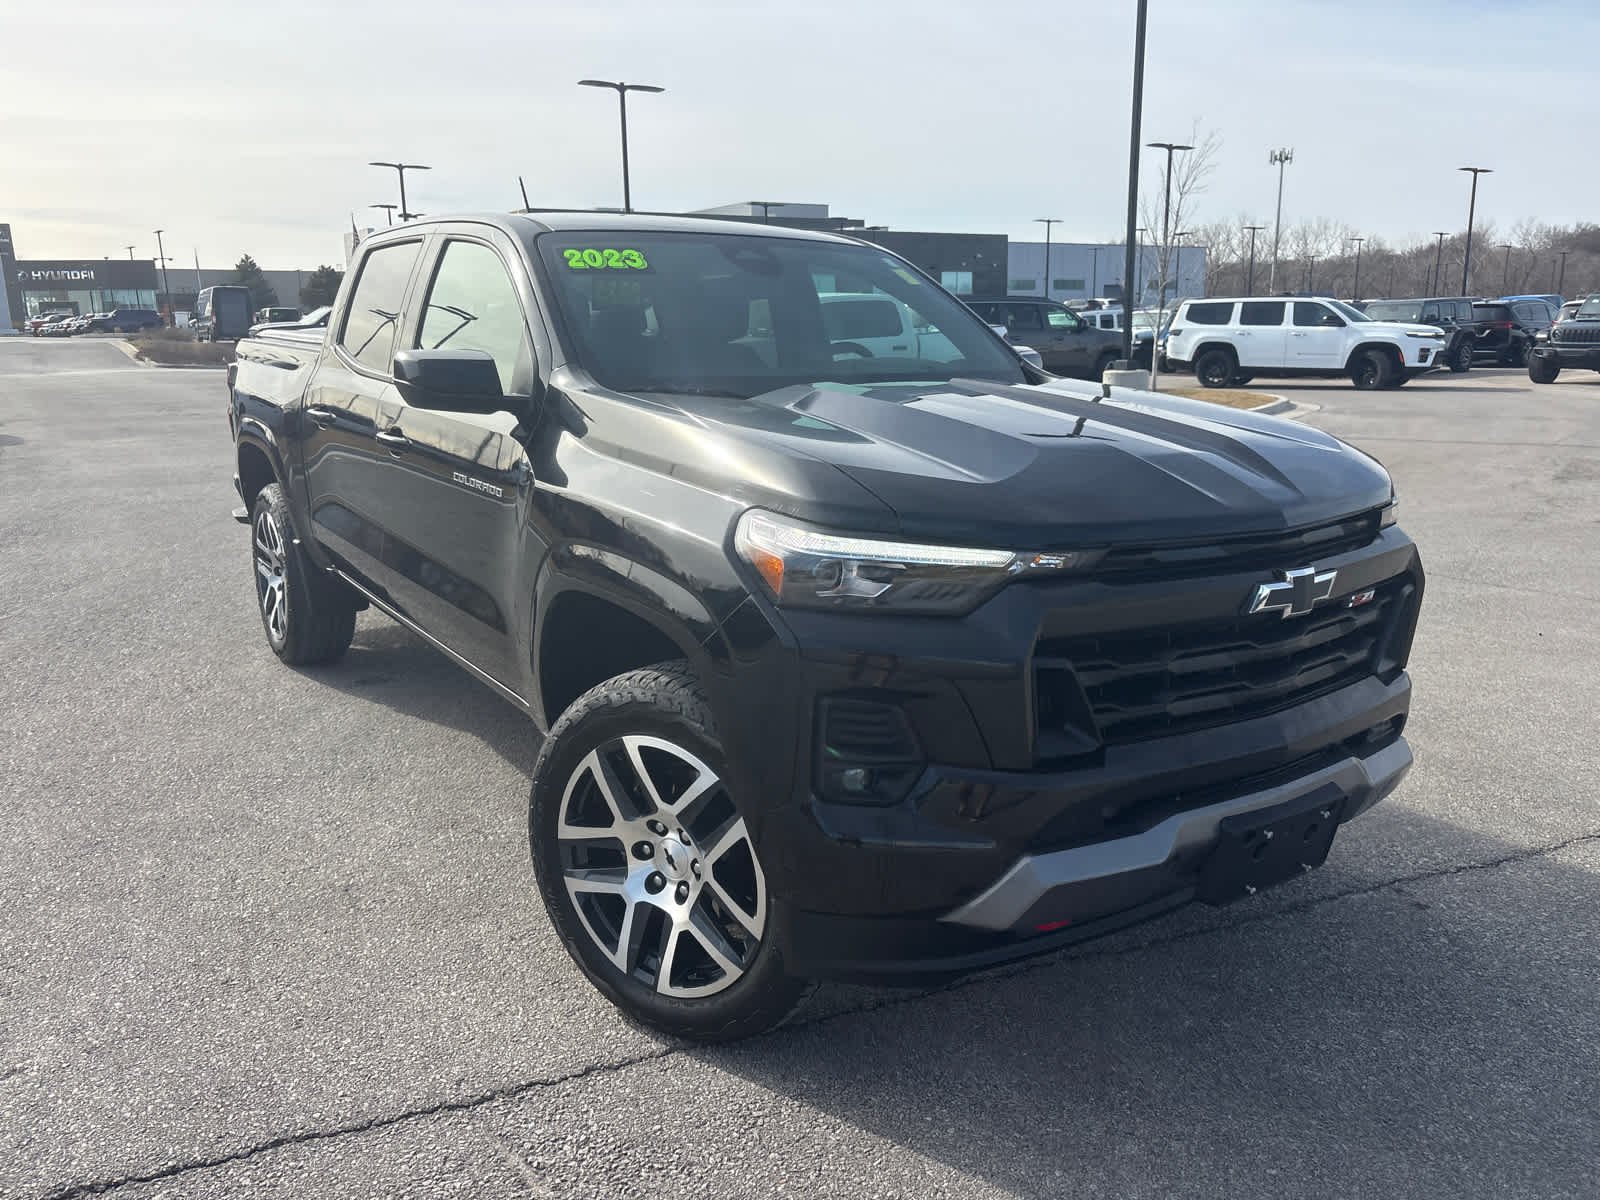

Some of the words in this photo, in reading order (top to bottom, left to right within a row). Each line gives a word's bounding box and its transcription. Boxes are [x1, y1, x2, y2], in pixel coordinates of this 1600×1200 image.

[563, 248, 648, 270] 2023
[31, 270, 95, 281] HYUNDAI
[453, 471, 503, 498] COLORADO
